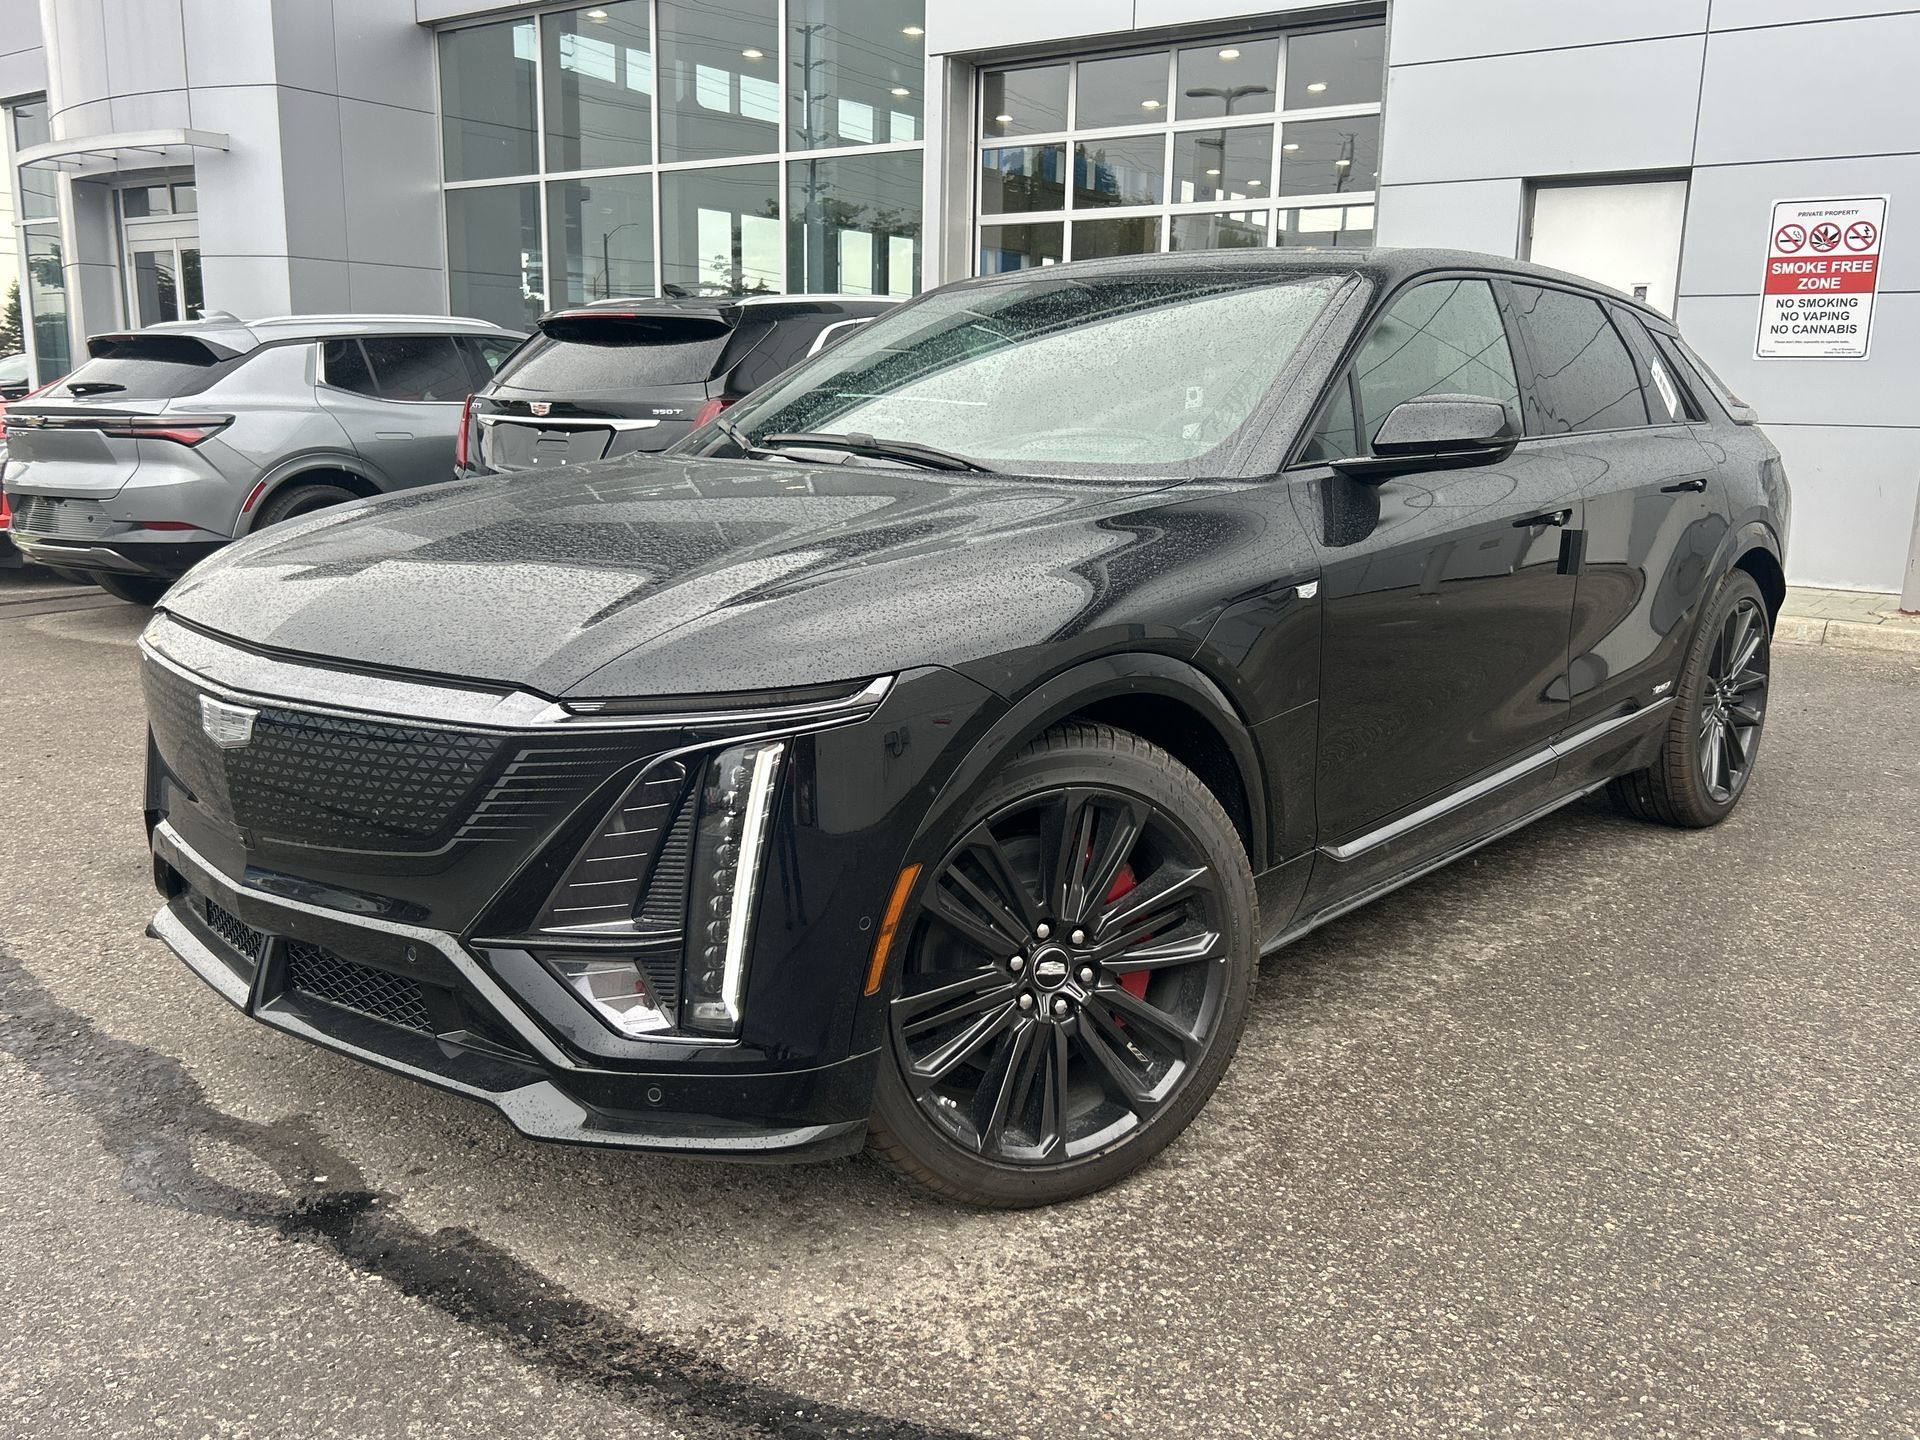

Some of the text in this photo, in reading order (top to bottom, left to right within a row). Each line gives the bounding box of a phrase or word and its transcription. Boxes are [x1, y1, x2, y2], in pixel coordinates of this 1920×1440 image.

[1771, 260, 1873, 275] SMOKE FREE
[1797, 277, 1841, 290] ZONE
[1776, 297, 1858, 308] NO SMOKING
[1780, 311, 1850, 321] NO VAPING
[1770, 324, 1857, 334] NO CANNABIS
